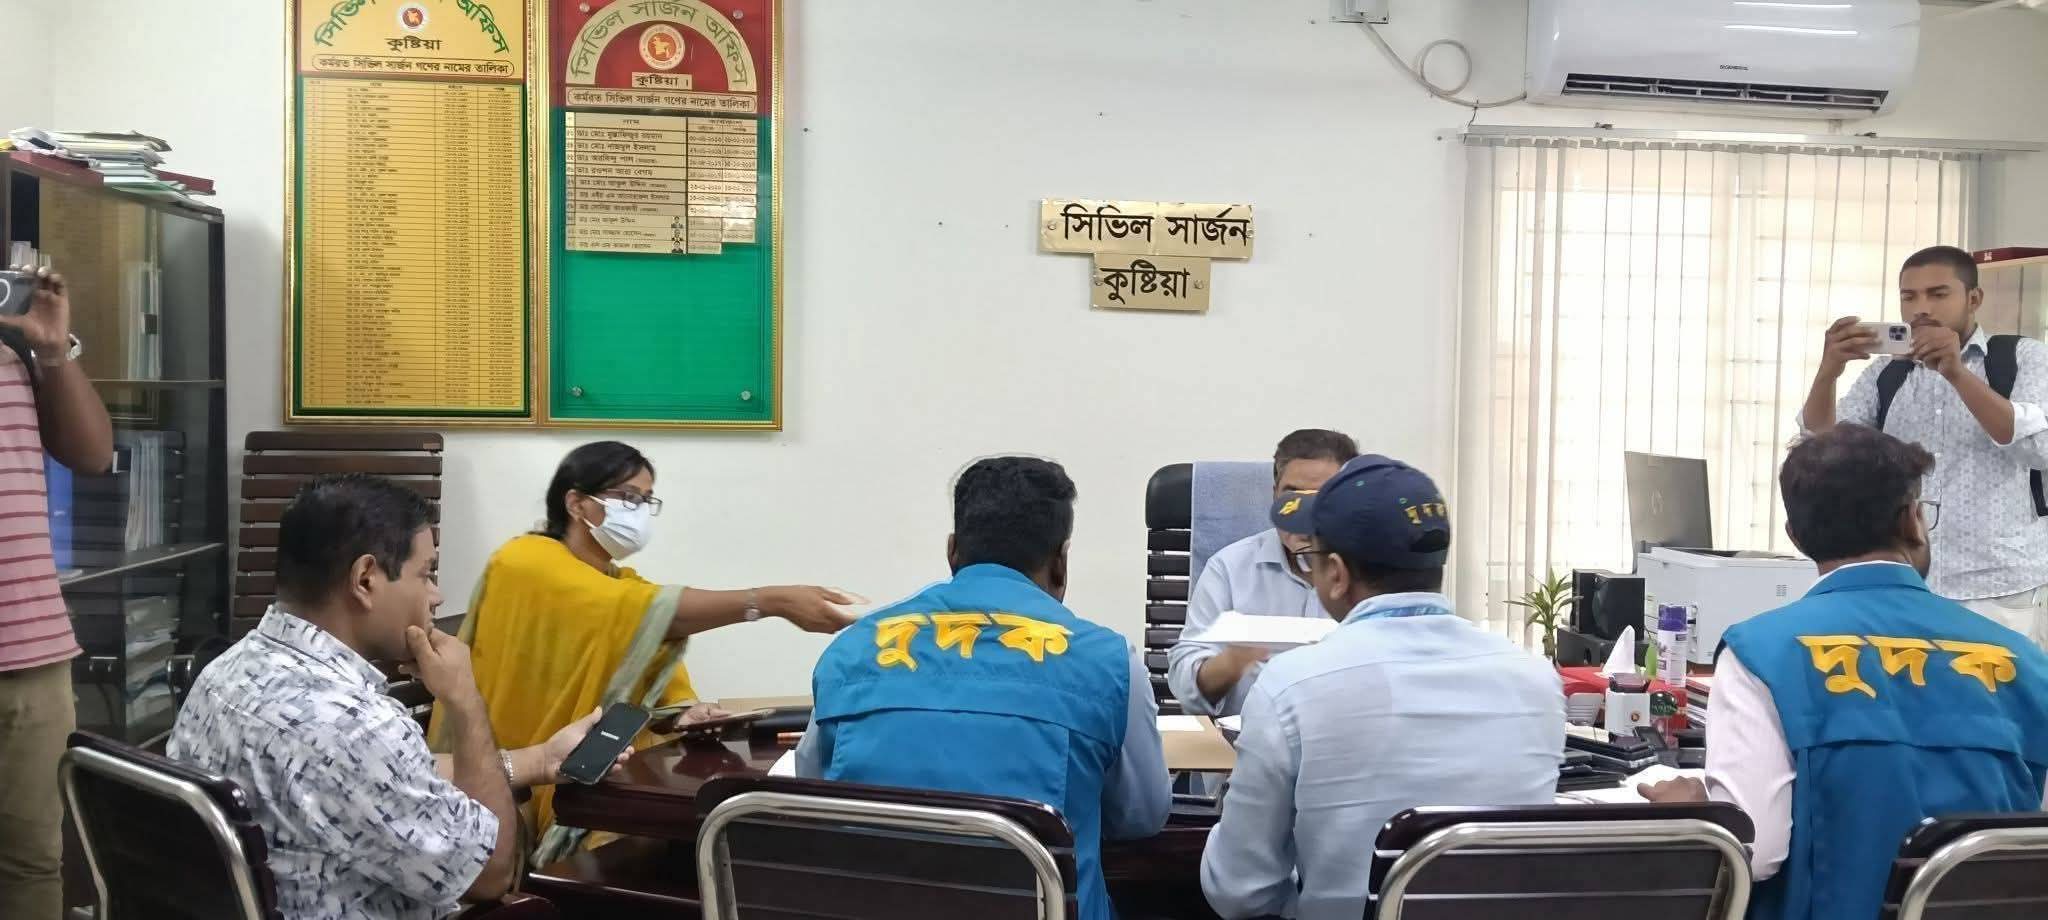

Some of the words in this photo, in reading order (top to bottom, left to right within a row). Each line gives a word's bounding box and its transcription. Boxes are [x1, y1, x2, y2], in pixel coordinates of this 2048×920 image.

[385, 35, 443, 51] কুষ্টিয়া
[570, 10, 625, 78] সিভিল
[629, 0, 697, 23] সার্জন
[706, 15, 749, 87] অফিস
[352, 57, 383, 69] সিভিল
[443, 62, 472, 74] নামের
[474, 63, 509, 75] তালিকা
[634, 73, 680, 87] কুষ্টিয়া
[719, 98, 751, 110] তালিকা
[1060, 203, 1155, 243] সিভিল
[1165, 207, 1251, 246] সার্জন
[1099, 259, 1190, 305] কুষ্টিয়া
[875, 612, 1075, 672] দুদক
[1795, 634, 2018, 699] দুদক
